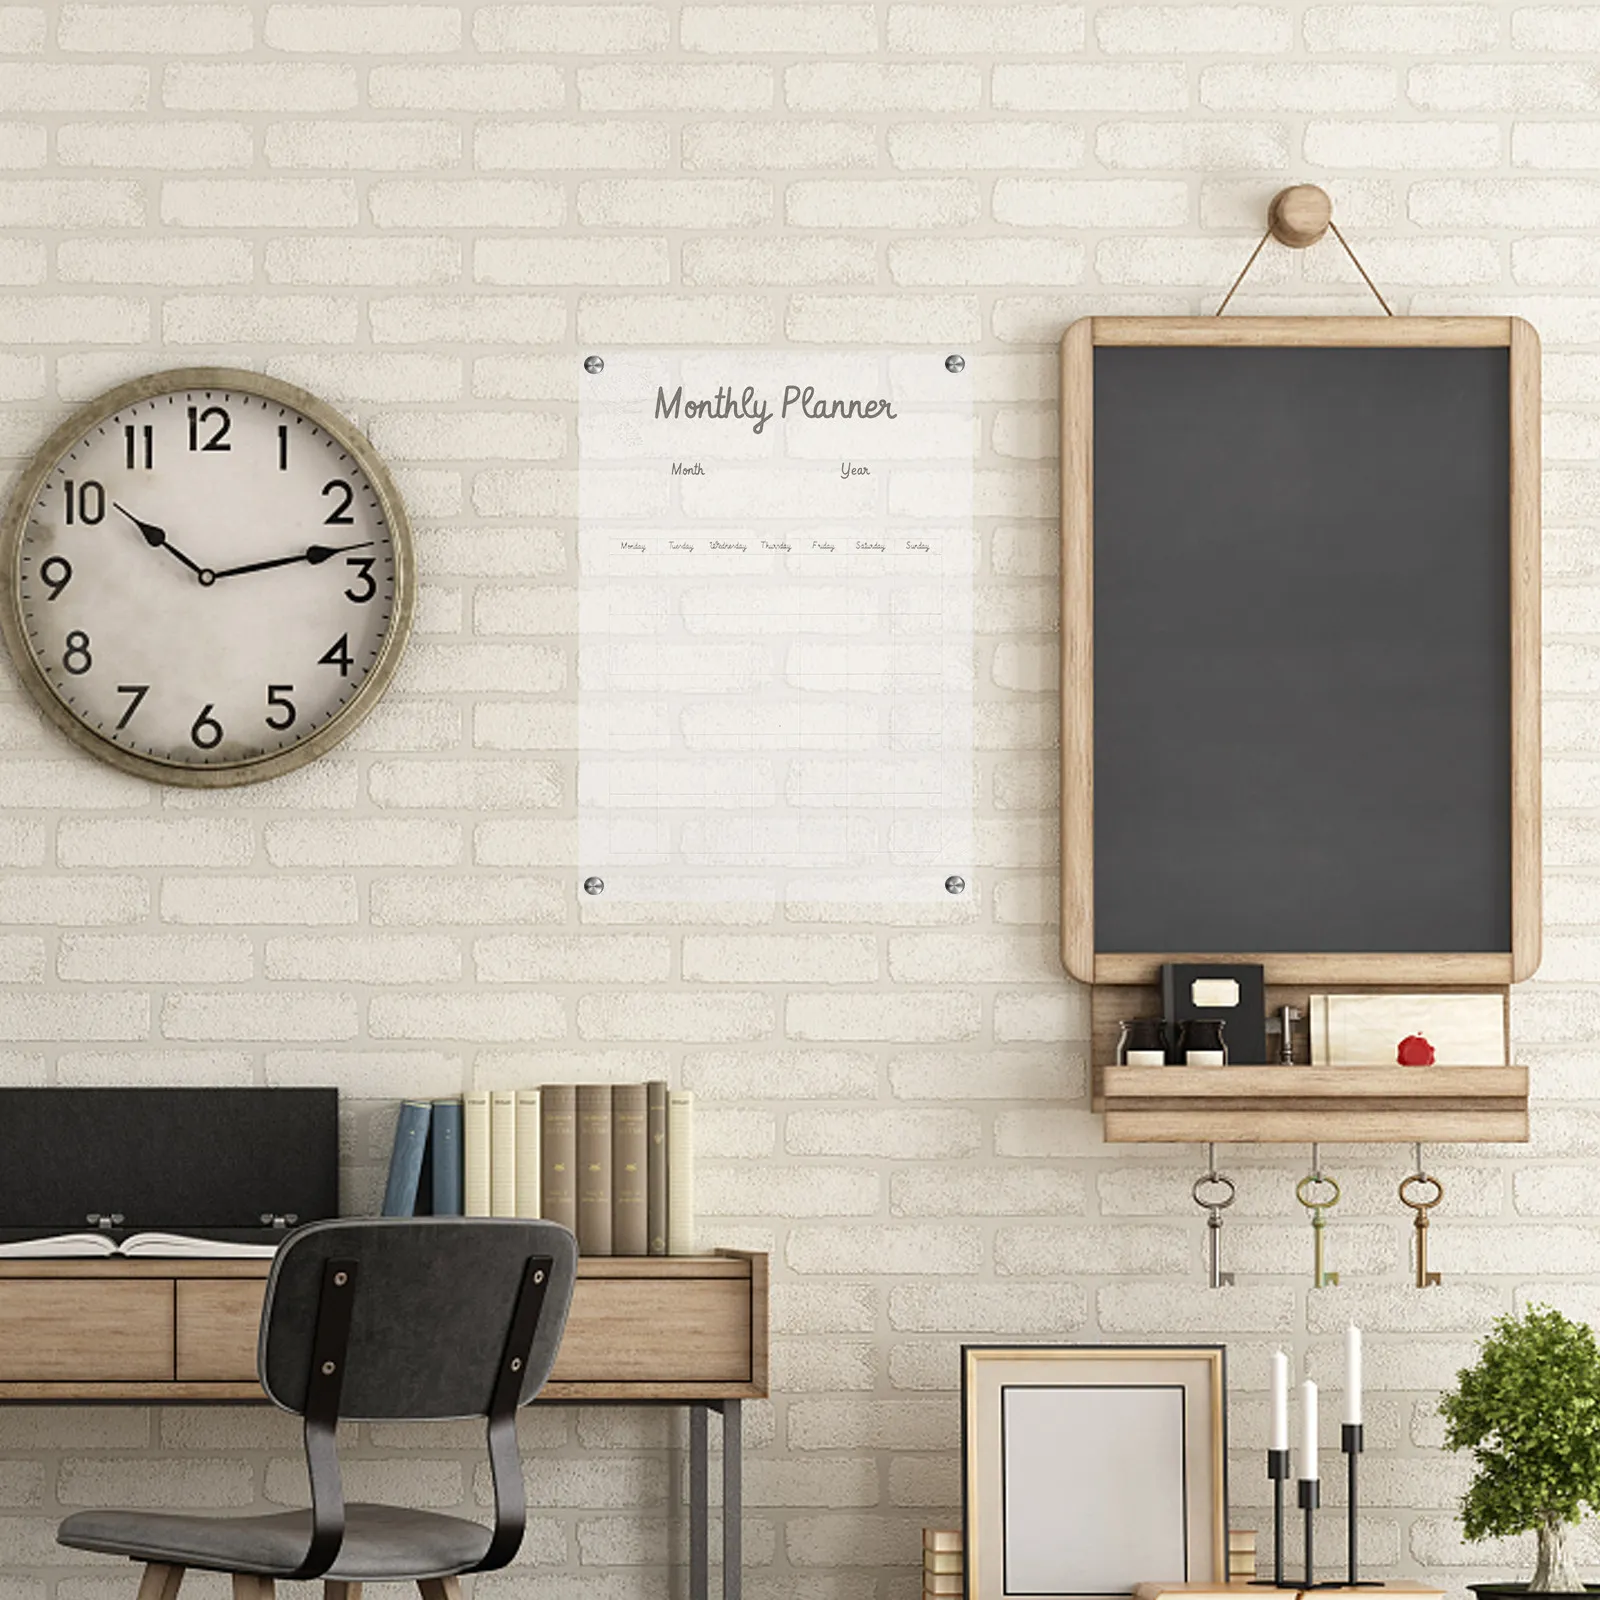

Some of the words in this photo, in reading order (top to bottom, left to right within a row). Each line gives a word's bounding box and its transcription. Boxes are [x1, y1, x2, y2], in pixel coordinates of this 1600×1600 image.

[187, 406, 231, 451] 12
[654, 385, 774, 435] Monthly
[781, 385, 898, 420] Planner
[124, 424, 153, 470] 11
[278, 425, 288, 471] 1
[671, 462, 706, 476] Month
[840, 462, 871, 480] Year
[63, 479, 105, 526] 10
[321, 479, 354, 525] 2
[620, 541, 647, 553] Monday
[668, 540, 695, 553] Tuesday
[709, 540, 748, 553] Wednesday
[760, 540, 792, 553] Thursday
[811, 540, 836, 553] Friday
[855, 540, 886, 553] Saturday
[905, 540, 931, 553] Sunday
[39, 556, 73, 602] 9
[344, 557, 377, 604] 3
[62, 630, 92, 676] 8
[317, 632, 355, 678] 4
[115, 685, 150, 731] 7
[190, 704, 224, 750] 6
[265, 684, 297, 732] 5
